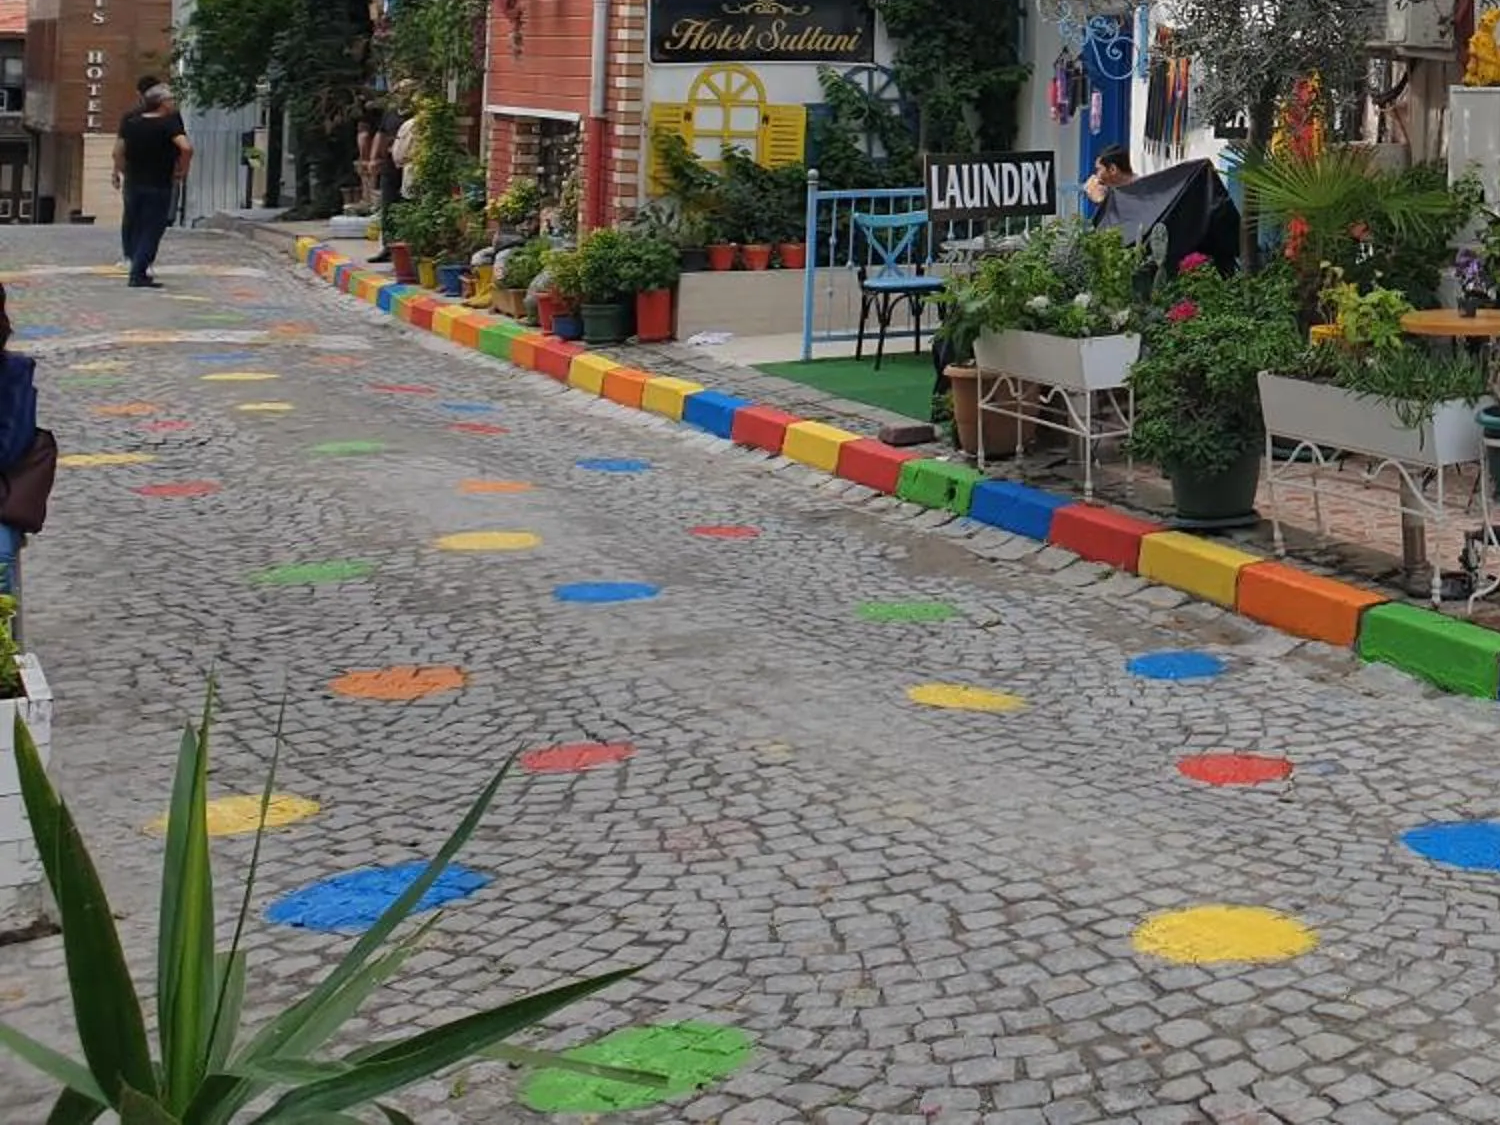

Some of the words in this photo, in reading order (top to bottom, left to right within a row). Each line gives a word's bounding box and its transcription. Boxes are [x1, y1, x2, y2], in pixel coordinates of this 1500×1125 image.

[664, 18, 755, 51] Hotel
[756, 18, 864, 52] Sultani
[86, 50, 103, 128] HOTEL
[930, 160, 1051, 210] LAUNDRY
